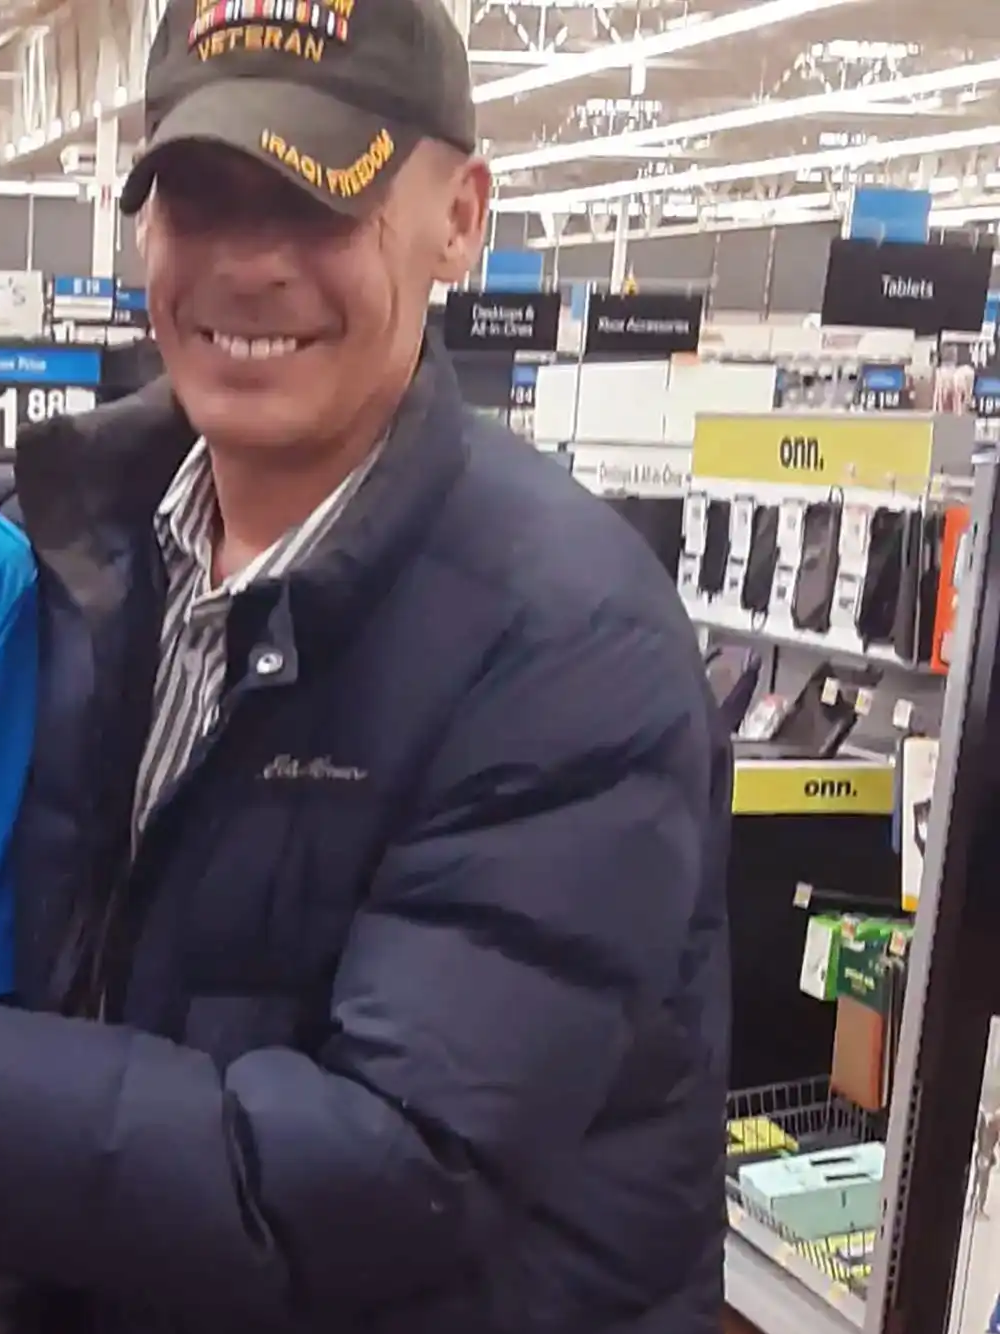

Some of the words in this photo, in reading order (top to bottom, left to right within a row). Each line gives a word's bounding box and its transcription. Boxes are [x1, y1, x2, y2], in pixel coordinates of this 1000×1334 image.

[198, 24, 324, 63] VETERAN
[261, 127, 322, 188] IRAQI
[326, 127, 394, 198] FREEDOM
[881, 273, 934, 299] Tablets
[18, 355, 47, 373] Price
[780, 435, 824, 471] onn.
[804, 779, 857, 798] onn.
